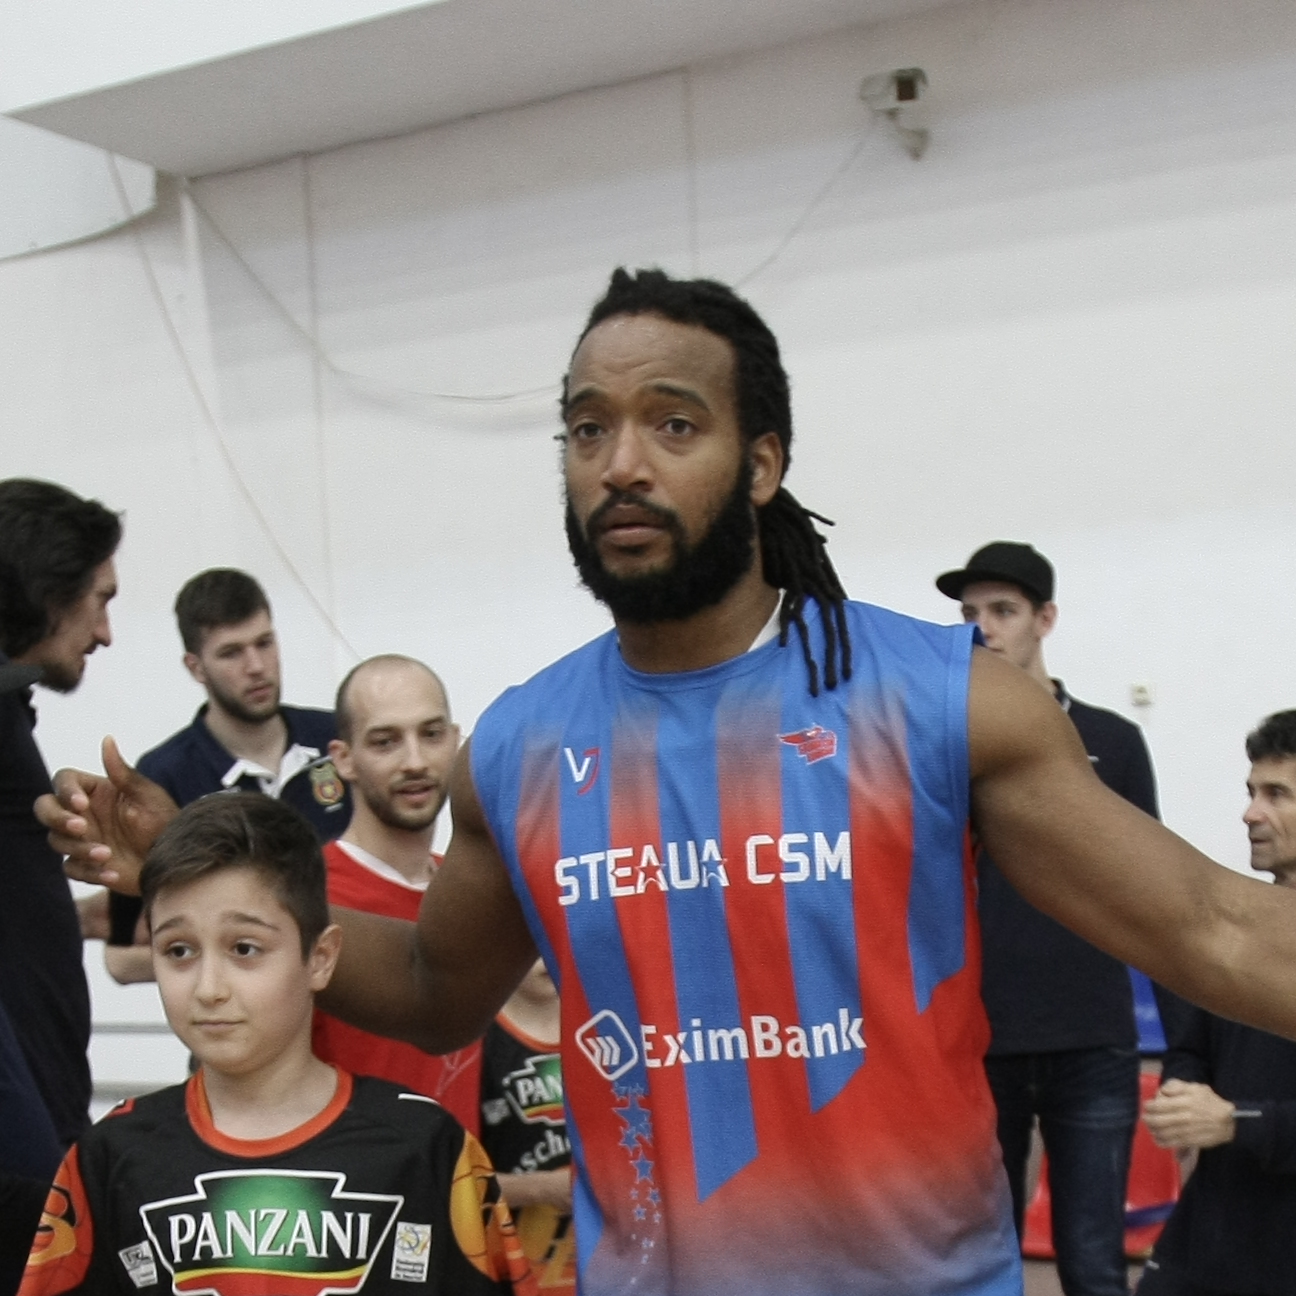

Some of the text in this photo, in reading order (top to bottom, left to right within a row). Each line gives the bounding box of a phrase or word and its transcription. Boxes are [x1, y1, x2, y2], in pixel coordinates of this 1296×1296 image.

[554, 830, 853, 907] STEAUA CSM
[640, 1007, 868, 1069] EximBank
[168, 1208, 372, 1263] PANZANI
